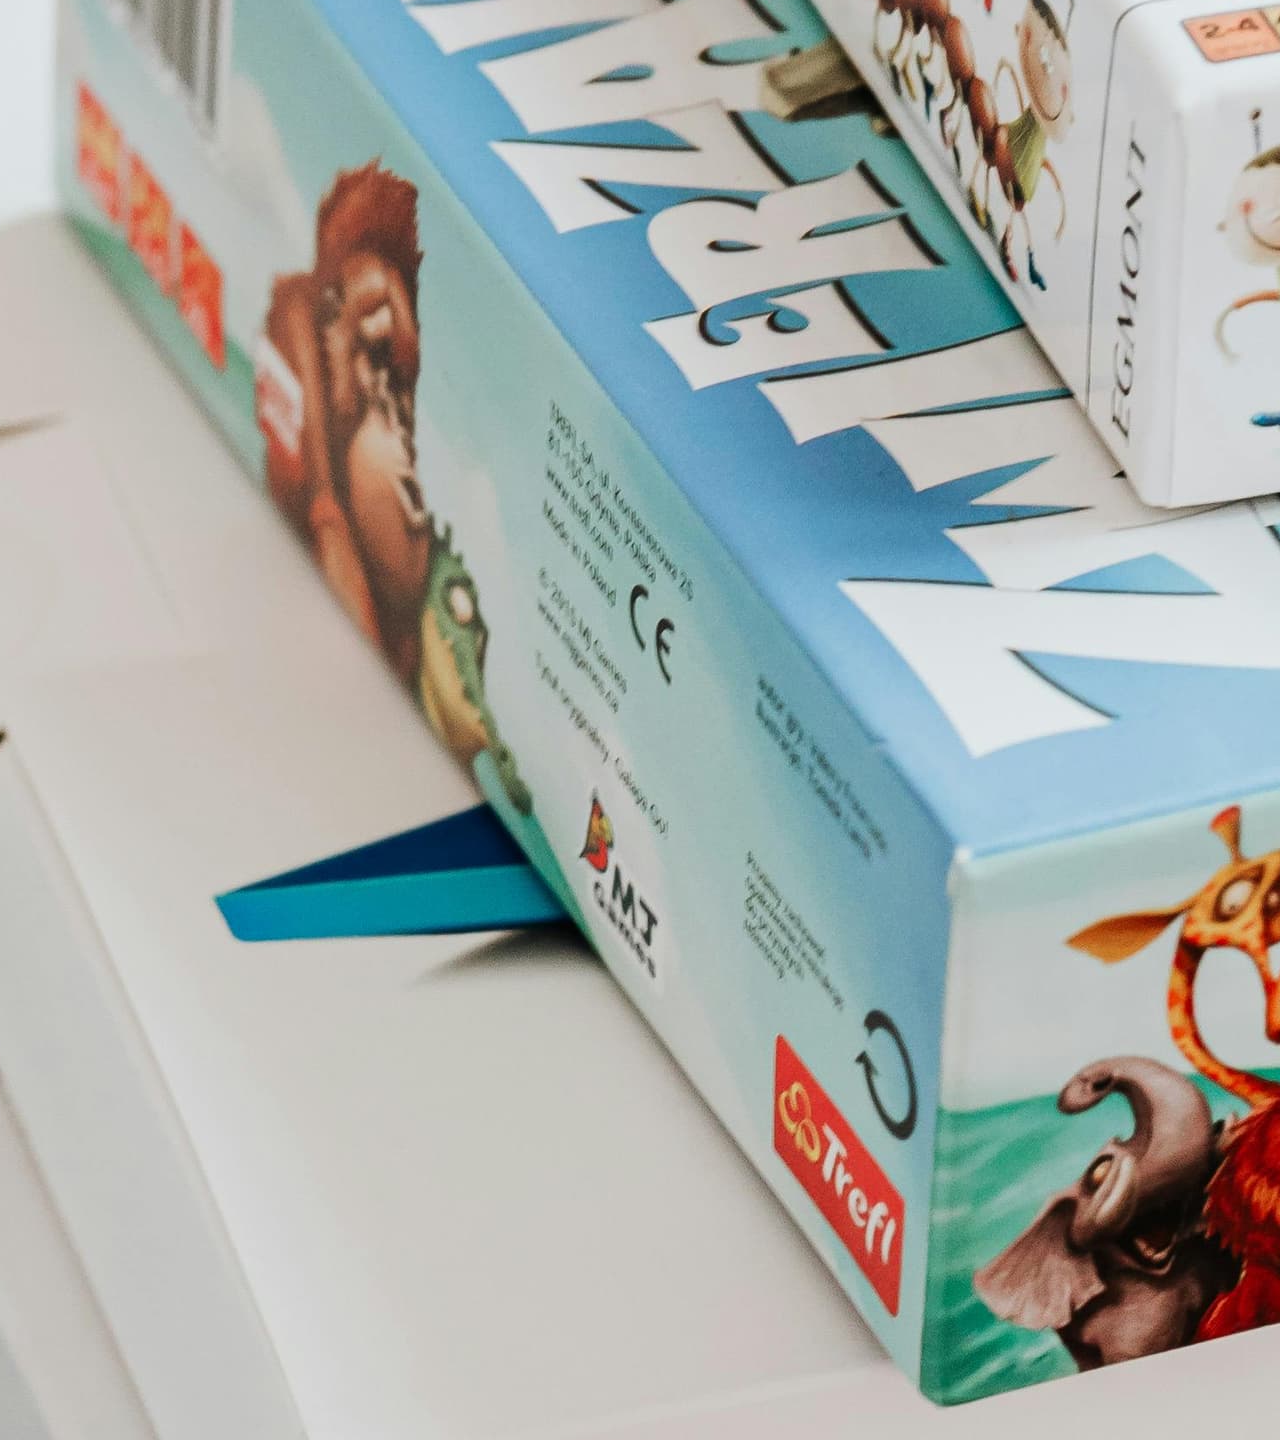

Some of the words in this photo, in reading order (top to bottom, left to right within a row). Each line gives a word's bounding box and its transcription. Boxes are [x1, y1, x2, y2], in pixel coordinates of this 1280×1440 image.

[1199, 16, 1262, 40] 2-4
[1111, 109, 1147, 449] EGMONT
[821, 1122, 897, 1265] Trefl
